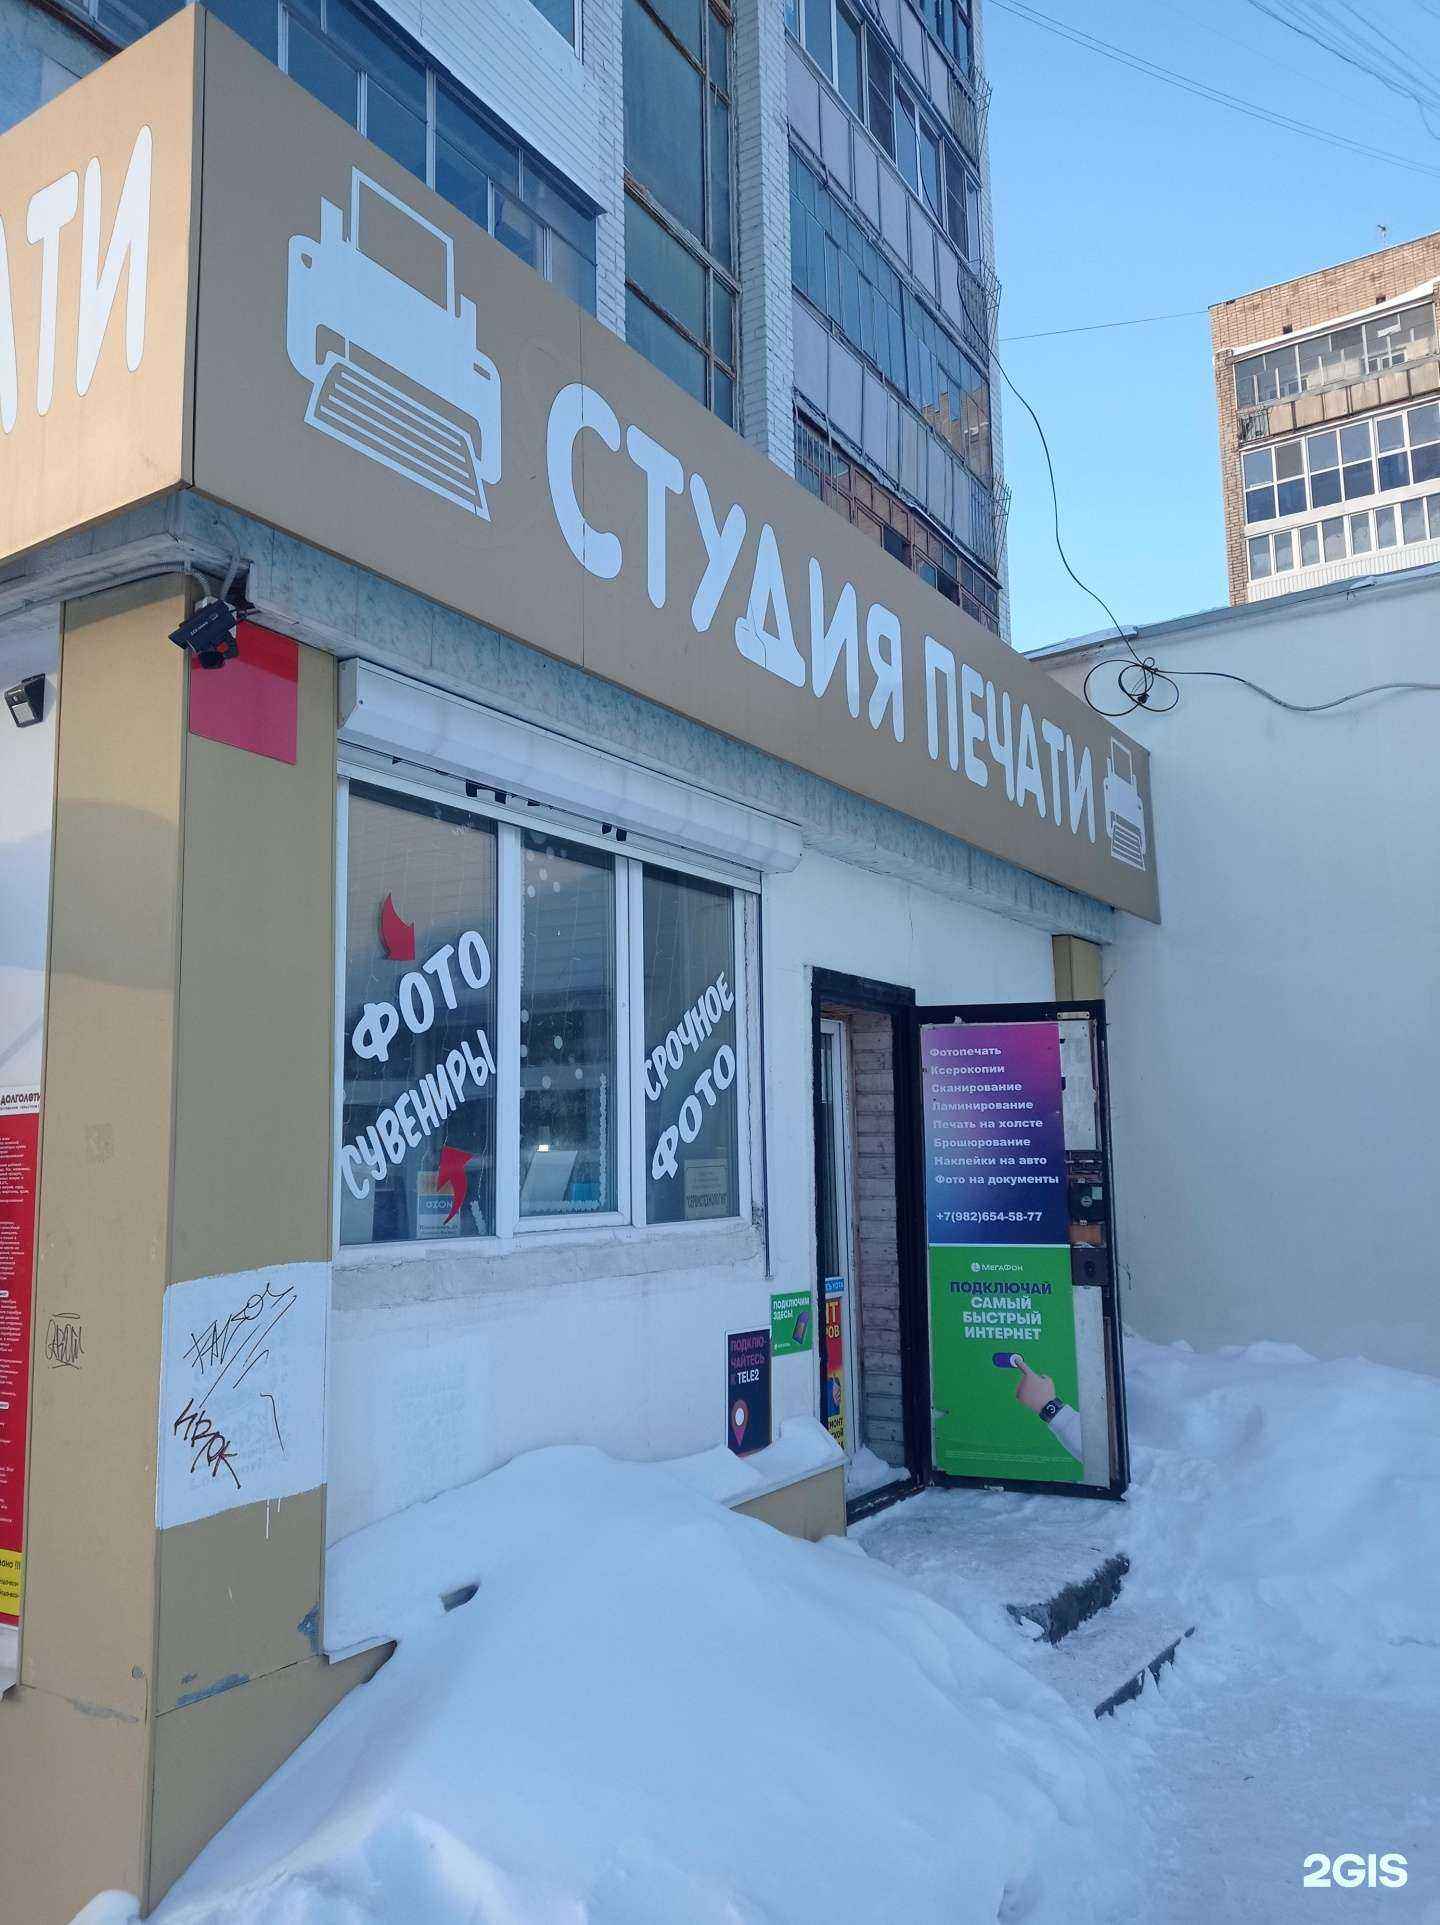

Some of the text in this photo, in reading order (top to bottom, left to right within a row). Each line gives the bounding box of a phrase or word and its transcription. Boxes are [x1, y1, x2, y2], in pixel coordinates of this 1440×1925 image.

[546, 382, 1096, 845] СТУДИЯ ПЕЧАТИ
[351, 930, 491, 1063] ФОТО
[643, 970, 735, 1102] СРОЧНОЕ
[929, 1047, 1002, 1057] Фотопечать
[931, 1065, 1005, 1076] Ксерокопии
[931, 1082, 1023, 1094] Сканирование
[651, 1044, 737, 1181] ФОТО
[932, 1101, 1034, 1112] Ламинирование
[341, 1029, 497, 1200] СУВЕНИРЫ
[933, 1118, 1043, 1129] Печать на холсте
[934, 1138, 1031, 1149] Брошюрование
[934, 1155, 1048, 1166] Наклейки на авто
[935, 1174, 1059, 1186] Фото на документы
[936, 1211, 1043, 1223] +7(982)654-58-77
[950, 1280, 1053, 1295] ПОДКЛЮЧАЙ
[971, 1295, 1032, 1310] САМЫЙ
[963, 1311, 1042, 1325] БЫСТРЫЙ
[964, 1326, 1042, 1340] ИНТЕРНЕТ
[731, 1353, 766, 1369] ЧАЙТЕСЬ
[737, 1368, 760, 1385] TELE2
